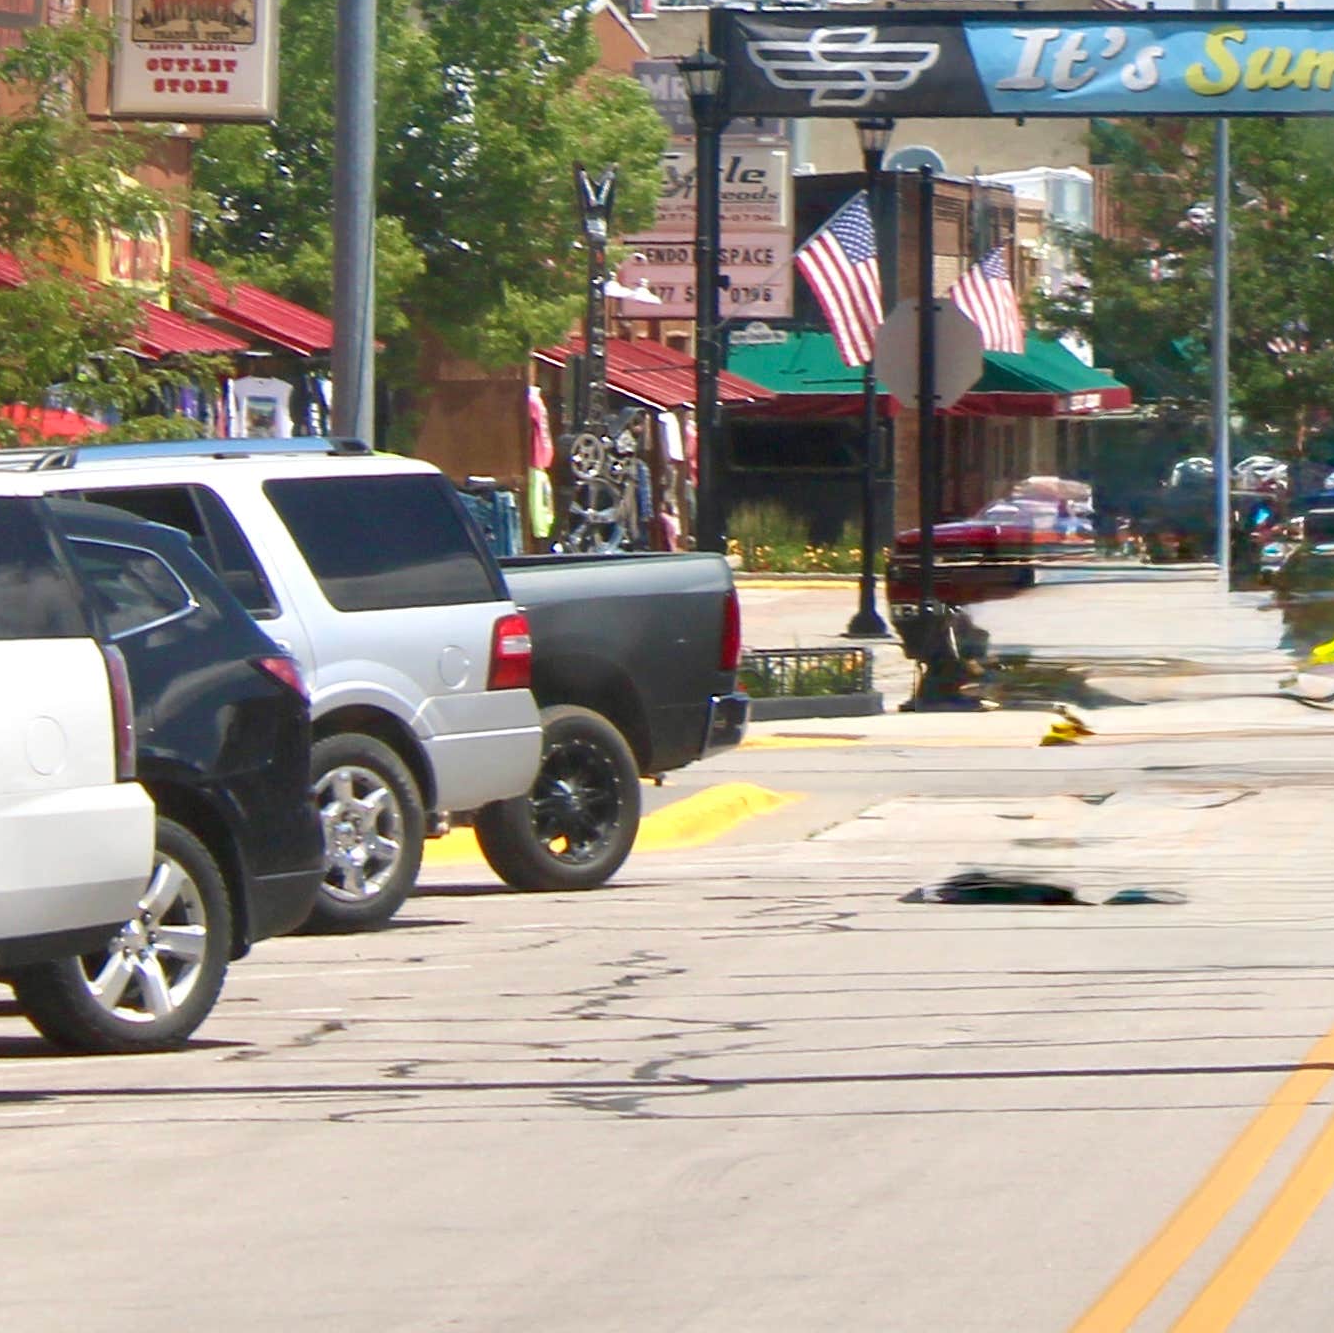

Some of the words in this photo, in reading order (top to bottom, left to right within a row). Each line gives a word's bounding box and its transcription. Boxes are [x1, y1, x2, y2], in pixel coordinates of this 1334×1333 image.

[146, 58, 238, 73] OUTLET
[995, 26, 1165, 93] It's
[154, 78, 230, 94] STORE
[719, 247, 774, 266] SPACE
